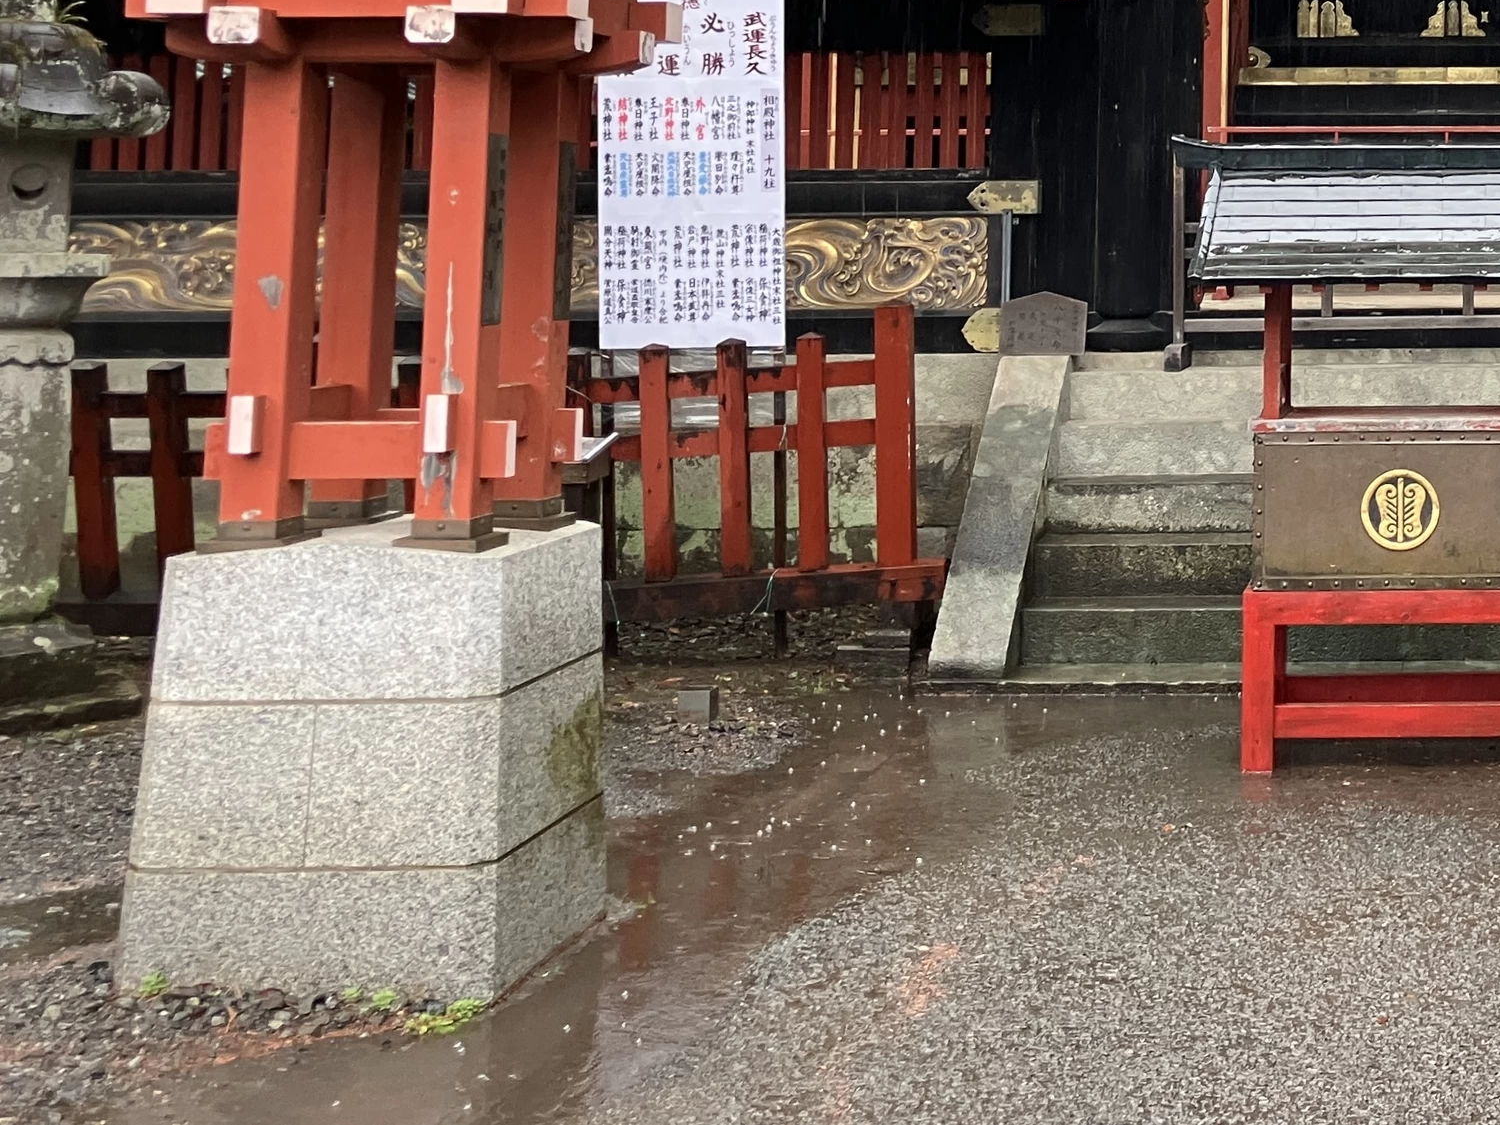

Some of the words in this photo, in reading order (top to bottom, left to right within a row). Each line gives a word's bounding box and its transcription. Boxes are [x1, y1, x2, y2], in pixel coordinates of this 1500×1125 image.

[701, 12, 725, 75] 必勝
[727, 21, 735, 66] ひっしょう
[744, 12, 767, 75] 武運長久
[603, 98, 613, 141] 荒神社
[618, 98, 628, 141] 結神社
[634, 98, 644, 141] 春日神社
[649, 97, 659, 140] 王子社
[665, 96, 675, 141] 北野神社
[681, 97, 690, 141] 春日神社
[696, 96, 705, 141] 外宮
[711, 96, 721, 140] 八幡宮
[763, 95, 775, 141] 相殿神社
[764, 155, 776, 189] 十九柱
[674, 226, 683, 269] 荒神社
[700, 225, 710, 269] 熊野神社
[731, 225, 740, 267] 荒神社
